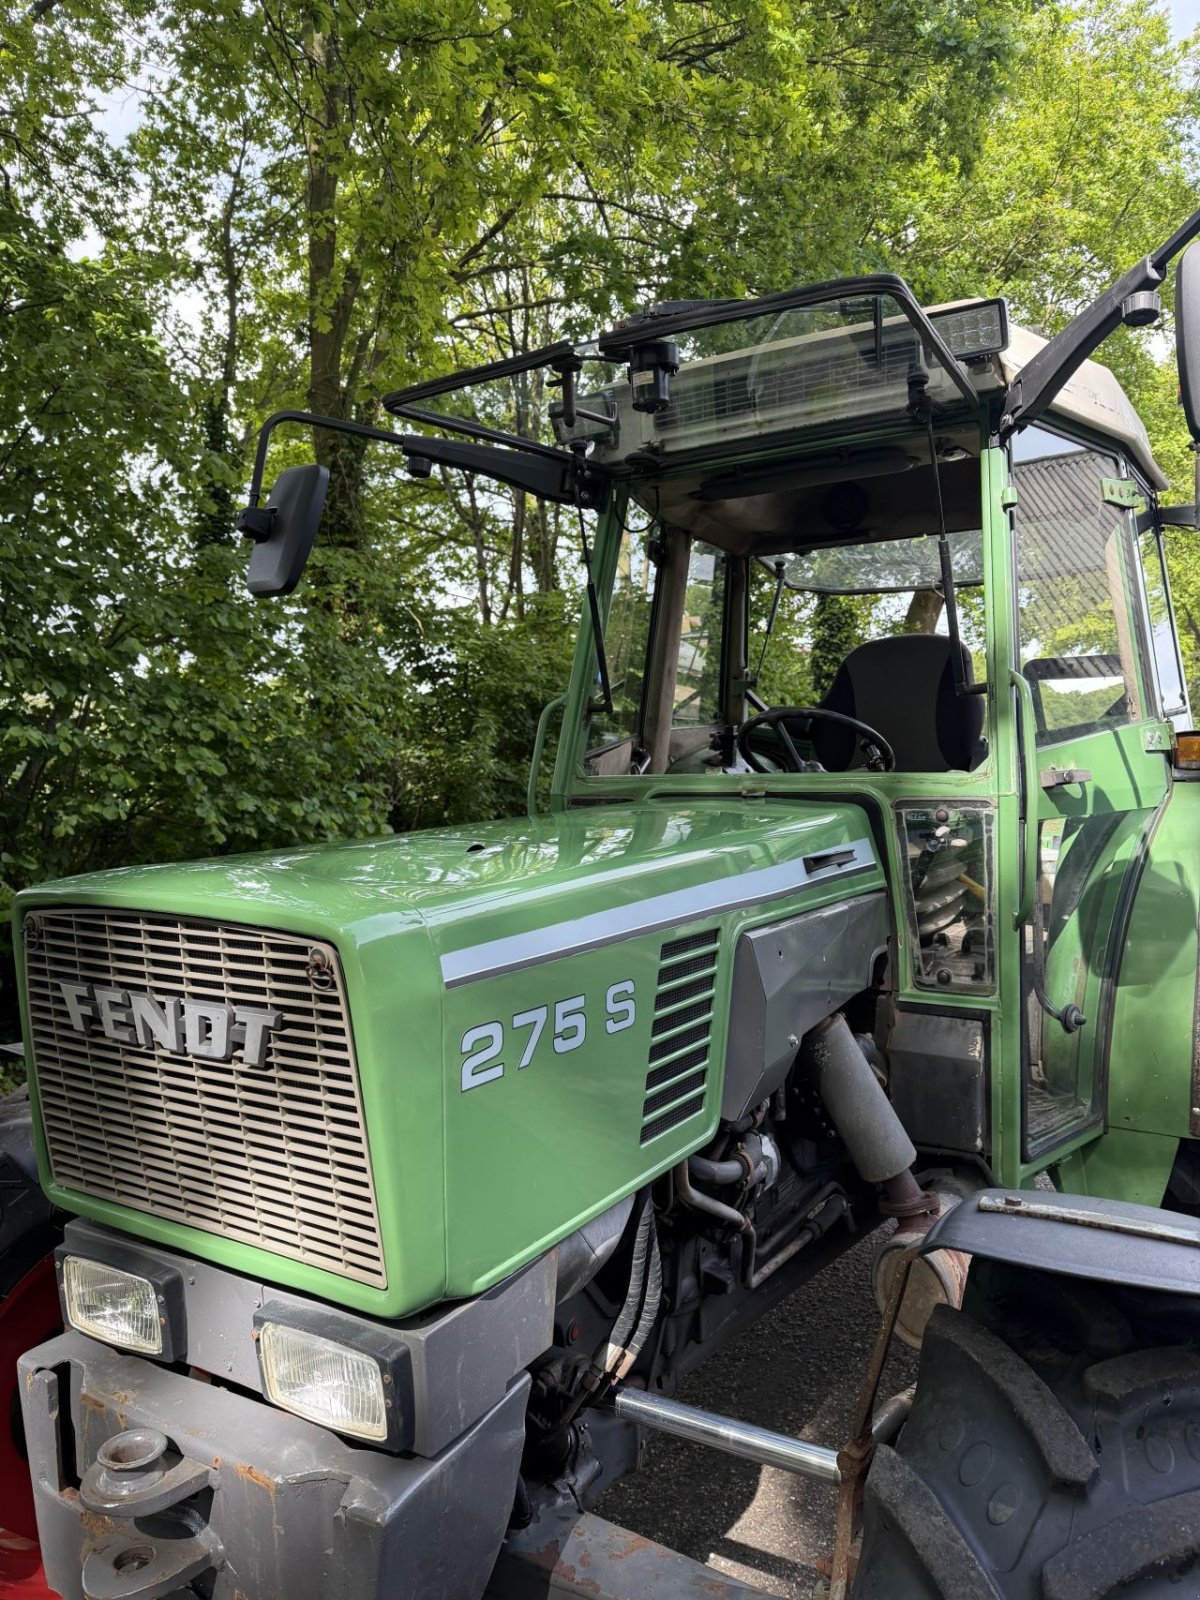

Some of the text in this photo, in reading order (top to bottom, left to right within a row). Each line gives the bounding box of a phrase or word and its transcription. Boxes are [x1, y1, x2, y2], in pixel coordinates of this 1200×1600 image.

[59, 979, 282, 1068] FENDT
[460, 978, 637, 1094] 275 S
